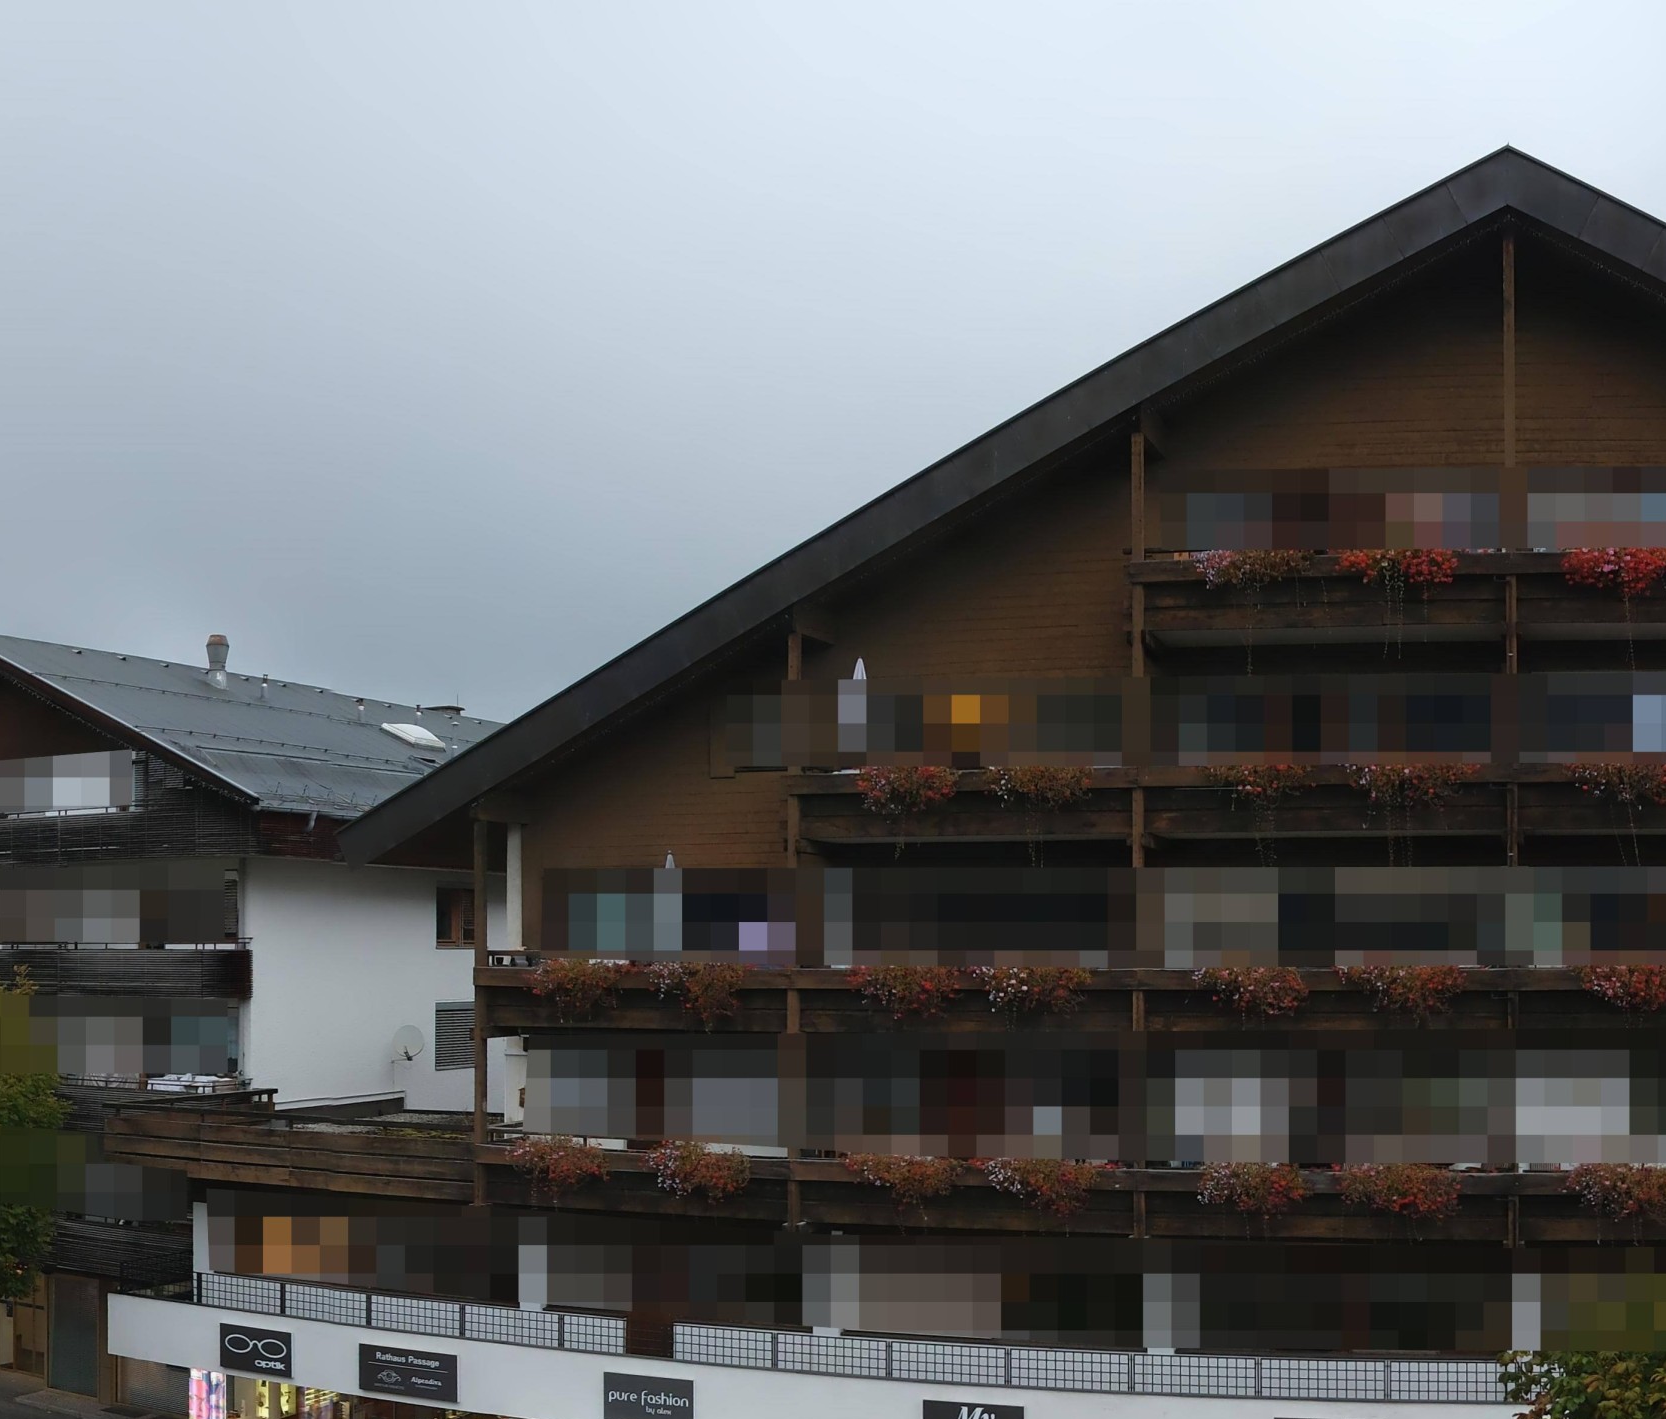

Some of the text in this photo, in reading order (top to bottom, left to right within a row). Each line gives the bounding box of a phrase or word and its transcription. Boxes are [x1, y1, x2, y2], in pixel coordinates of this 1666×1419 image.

[255, 1360, 286, 1371] optik
[375, 1352, 440, 1368] Rathaus Passage
[608, 1390, 689, 1408] pure fashion
[645, 1407, 672, 1416] by alex
